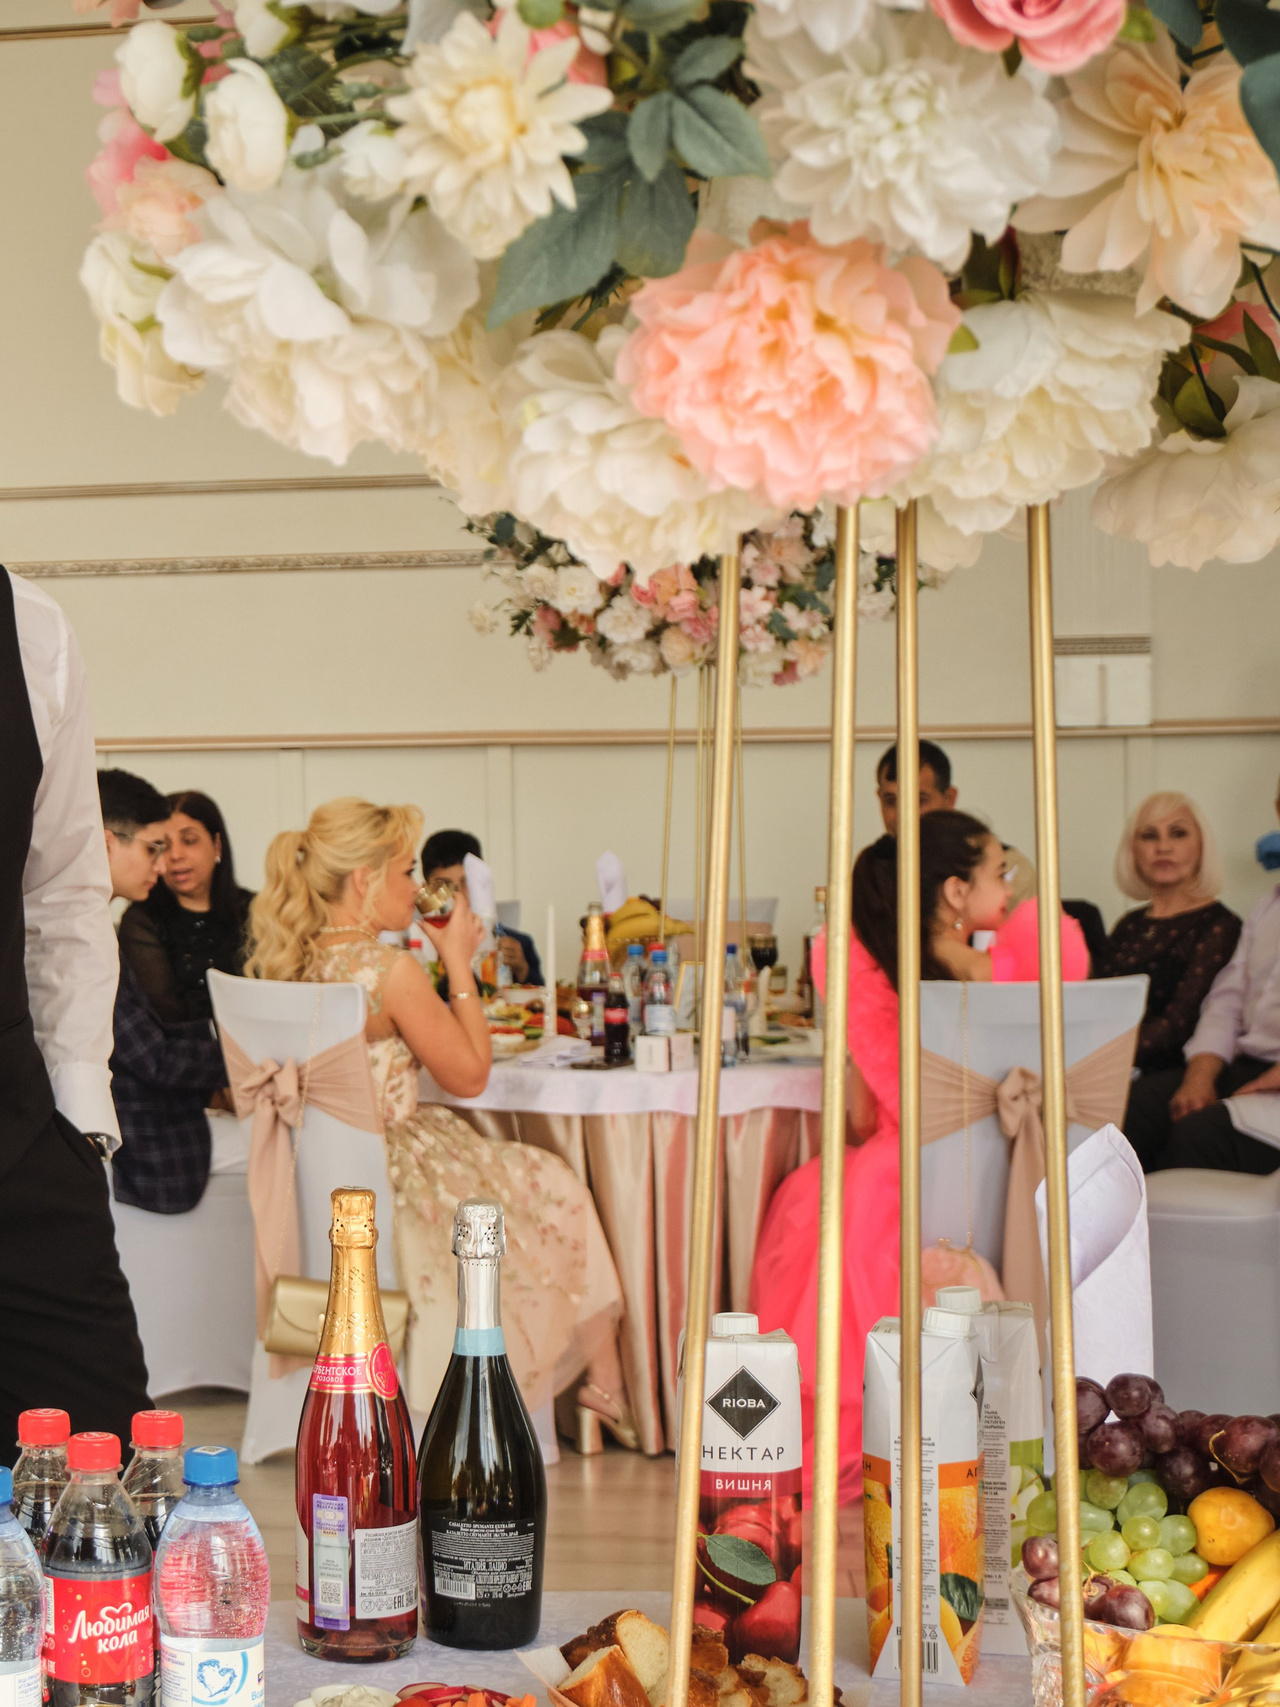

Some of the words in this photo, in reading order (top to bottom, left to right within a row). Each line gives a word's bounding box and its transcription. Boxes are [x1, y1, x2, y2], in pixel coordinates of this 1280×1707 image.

[313, 1364, 362, 1376] ЕРБЕНТСКОЕ
[316, 1375, 344, 1383] РОЗОВОЕ
[722, 1398, 766, 1408] RIOBA
[702, 1445, 785, 1461] НЕКТАР
[715, 1479, 772, 1491] ВИШНЯ
[68, 1602, 150, 1643] Любимая
[98, 1630, 138, 1653] кола
